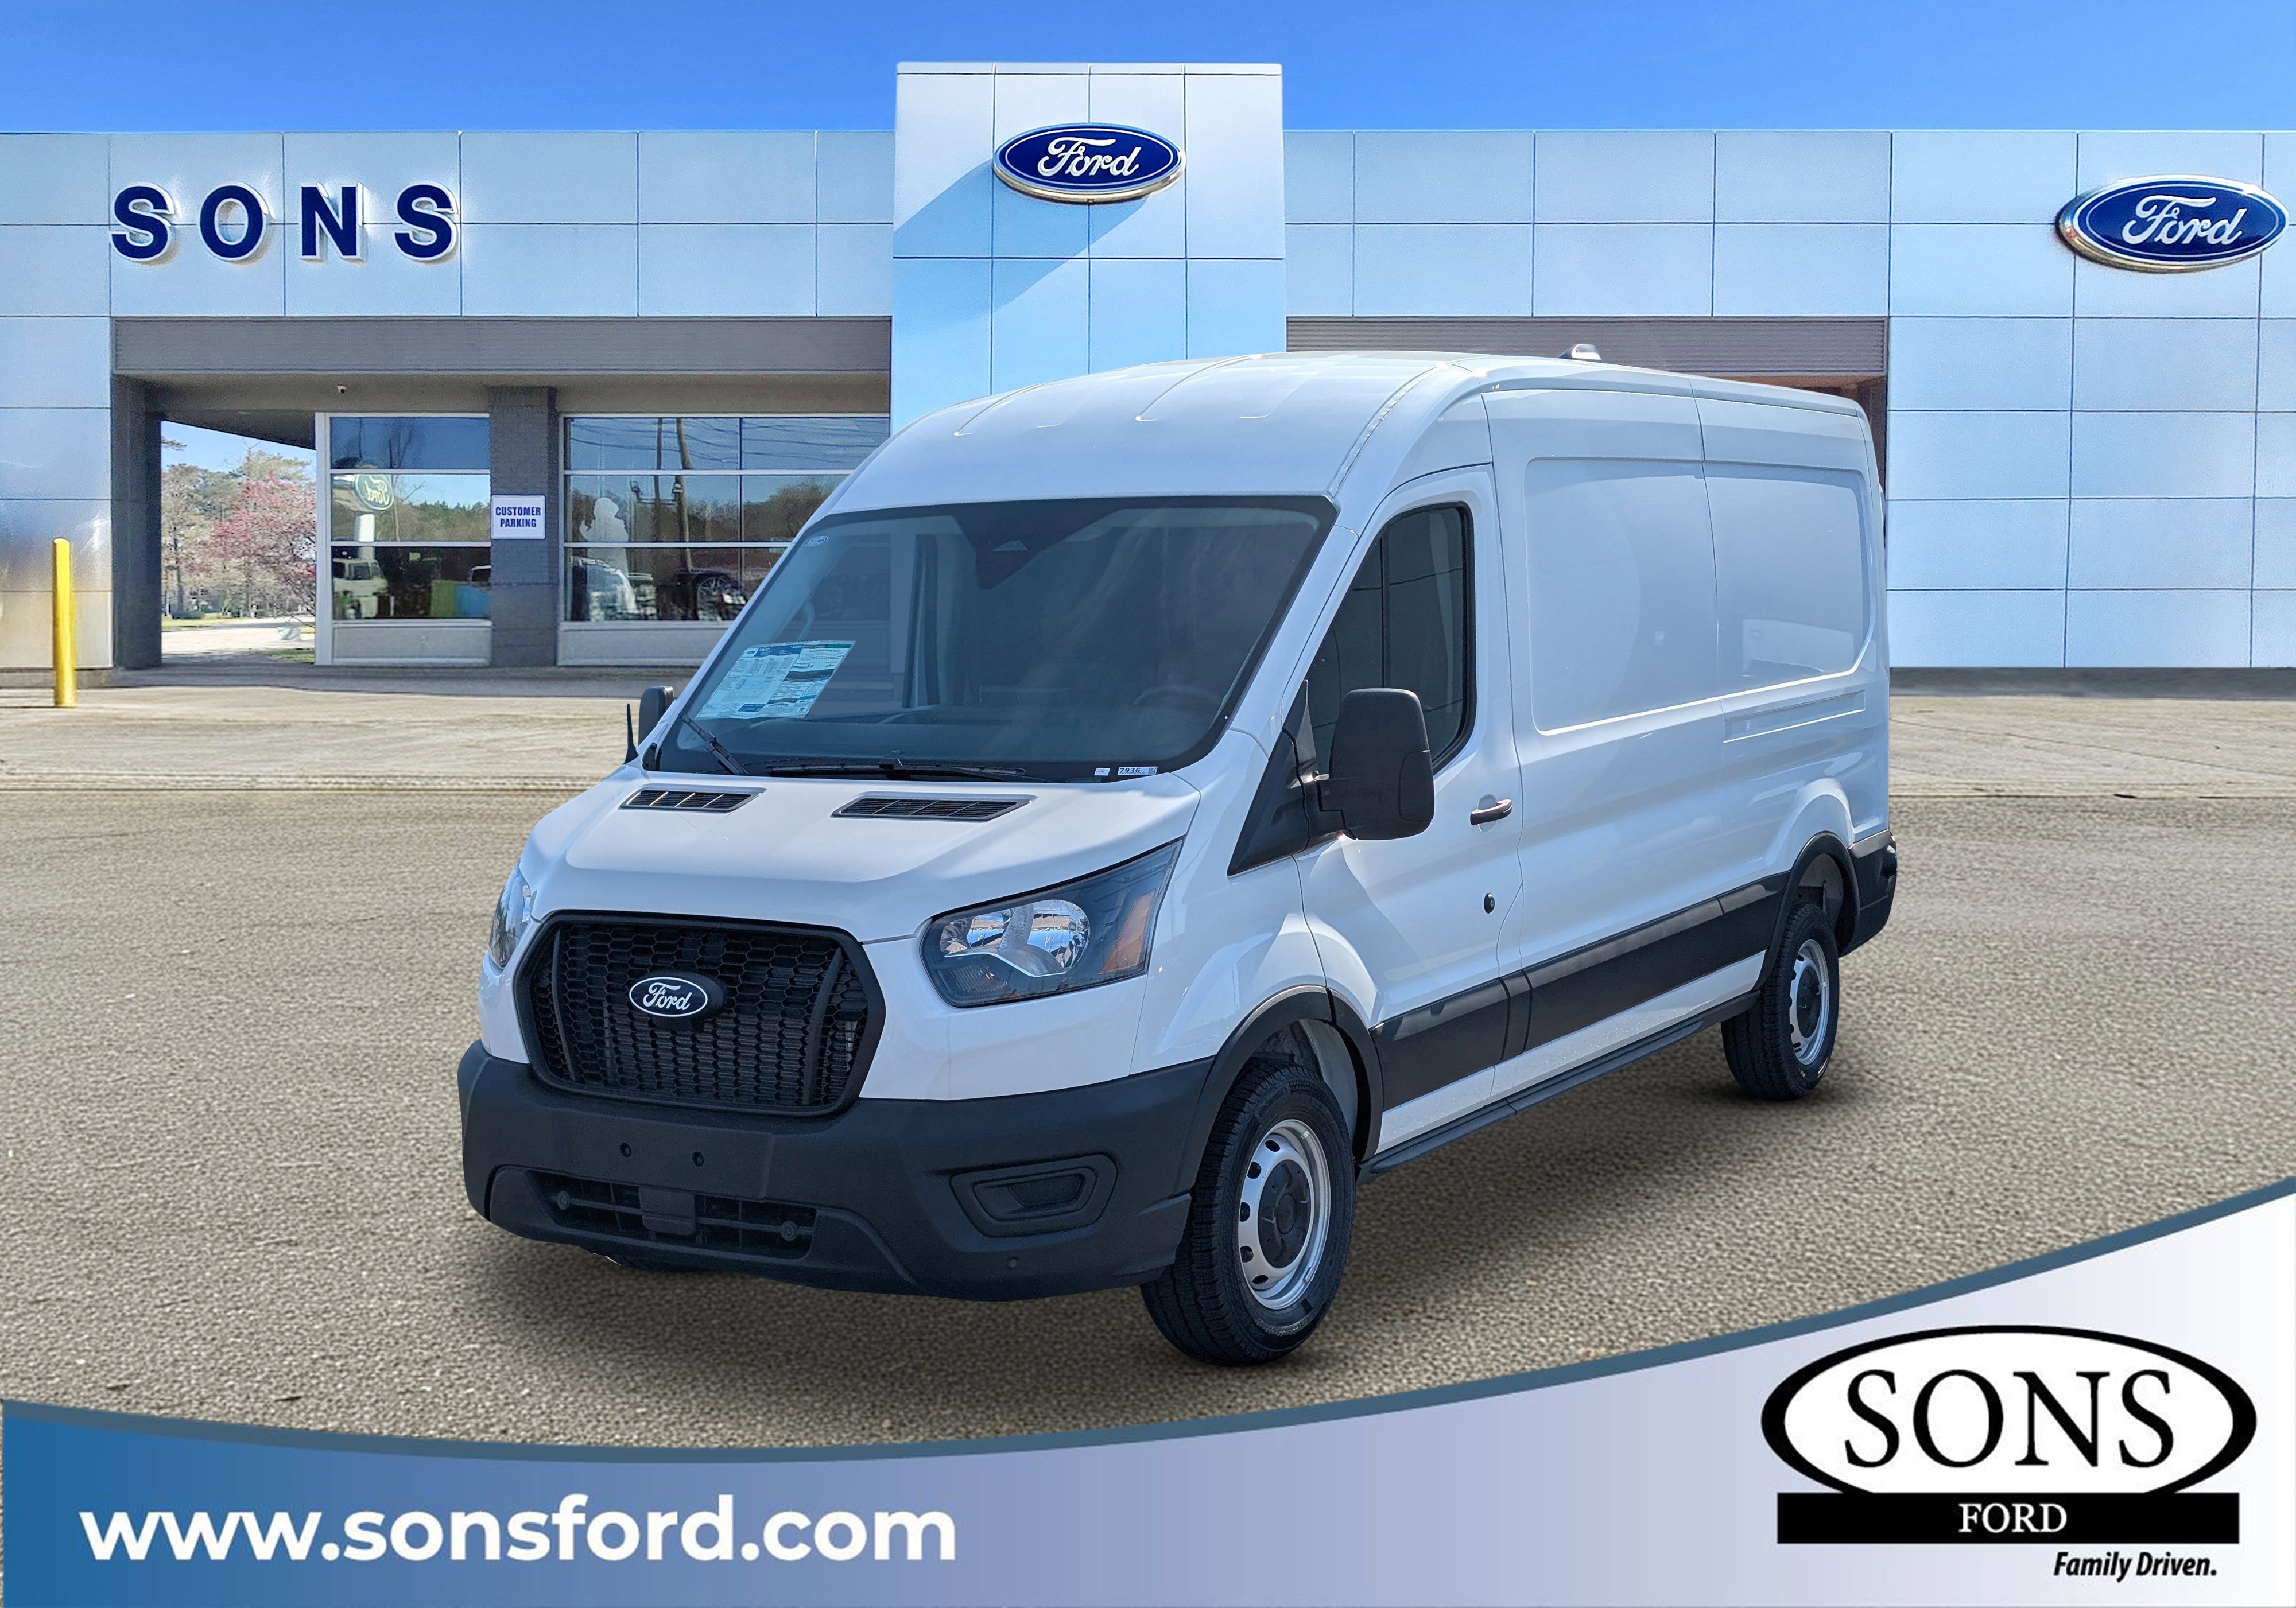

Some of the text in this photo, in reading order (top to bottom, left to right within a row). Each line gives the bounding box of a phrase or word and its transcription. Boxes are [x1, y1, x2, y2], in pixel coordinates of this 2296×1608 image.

[1037, 137, 1142, 177] Ford
[111, 183, 458, 260] SONS
[2122, 195, 2247, 246] Ford
[495, 507, 541, 516] CUSTOMER
[500, 518, 537, 527] PARKING
[643, 982, 693, 1011] Ford
